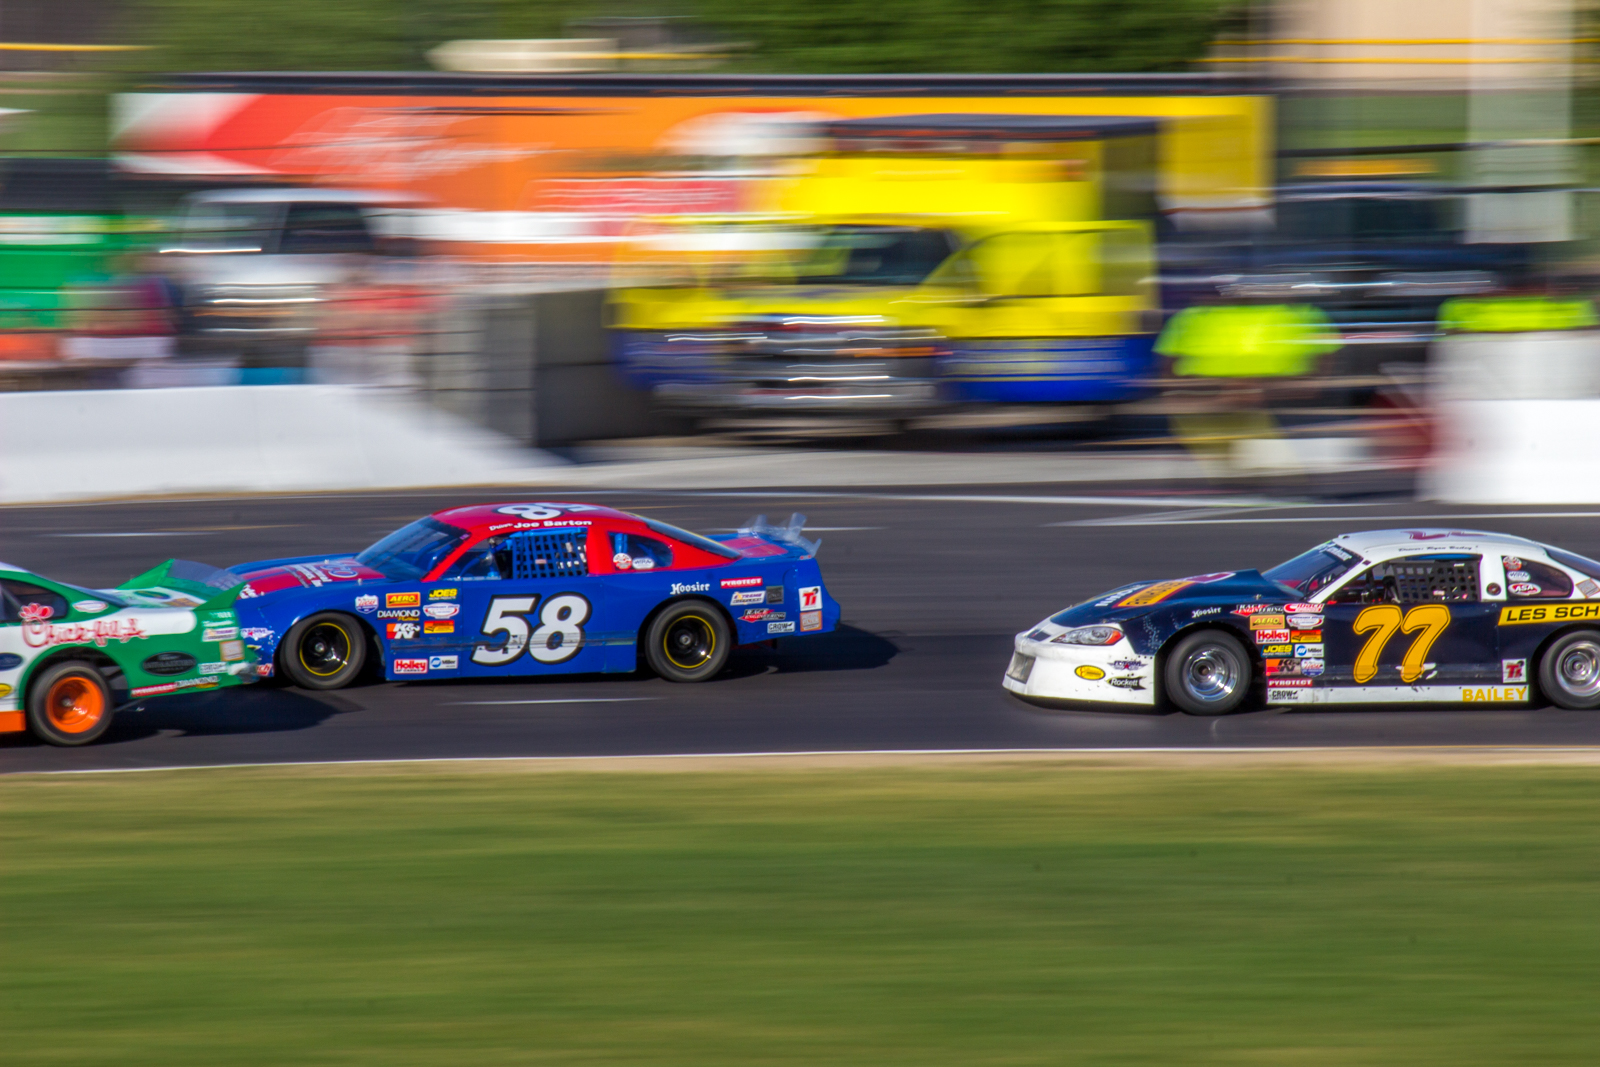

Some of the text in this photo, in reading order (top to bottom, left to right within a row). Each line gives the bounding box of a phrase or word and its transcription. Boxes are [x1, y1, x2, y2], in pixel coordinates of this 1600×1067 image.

[720, 577, 762, 587] PYROTECT
[429, 588, 458, 598] JOES
[670, 581, 711, 595] Hoosier
[1514, 584, 1534, 593] ASA
[803, 592, 818, 607] Ti
[377, 609, 420, 618] DIAMOND
[1191, 607, 1222, 618] Hoosier
[1506, 608, 1547, 622] LES
[471, 592, 592, 666] 58
[768, 621, 788, 630] CROW
[1257, 630, 1289, 642] Holley
[1263, 644, 1293, 653] JOES
[1353, 604, 1451, 684] 77
[395, 659, 426, 672] Holley
[1111, 678, 1139, 686] Rockett
[1268, 679, 1312, 687] PYROTECT
[1462, 687, 1527, 702] BAILEY
